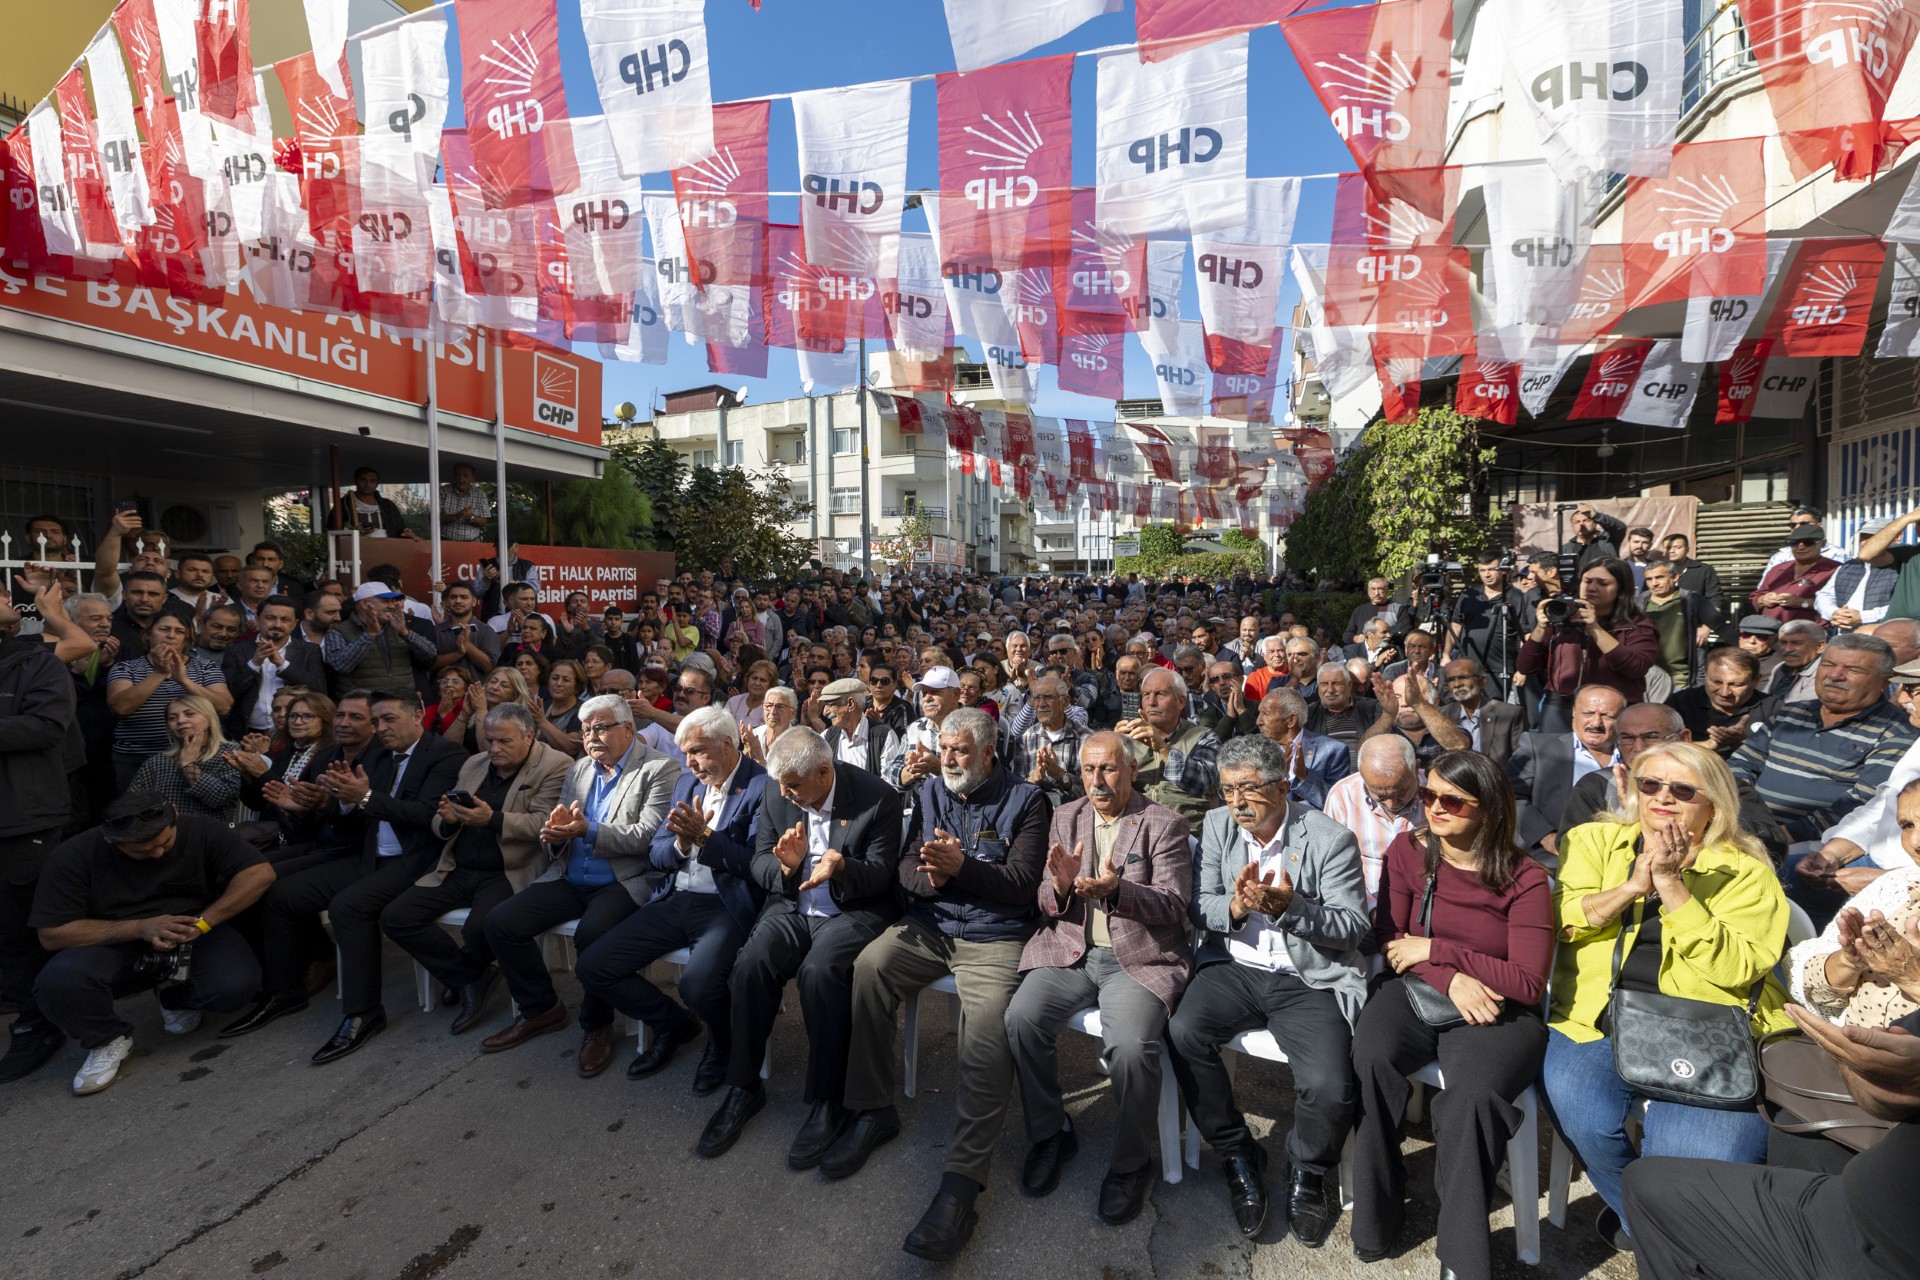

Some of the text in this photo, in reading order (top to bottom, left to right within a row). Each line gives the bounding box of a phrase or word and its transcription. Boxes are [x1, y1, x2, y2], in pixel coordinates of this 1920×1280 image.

[87, 279, 368, 375] BAŞKANLIĞI
[1523, 374, 1552, 393] CHP
[1591, 382, 1629, 398] CHP
[1643, 381, 1688, 399] CHP
[1763, 376, 1807, 392] CHP
[1728, 385, 1753, 400] CHP
[538, 403, 574, 426] CHP
[559, 566, 592, 581] HALK
[597, 566, 637, 582] PARTİSİ
[592, 585, 637, 602] PARTİSİ
